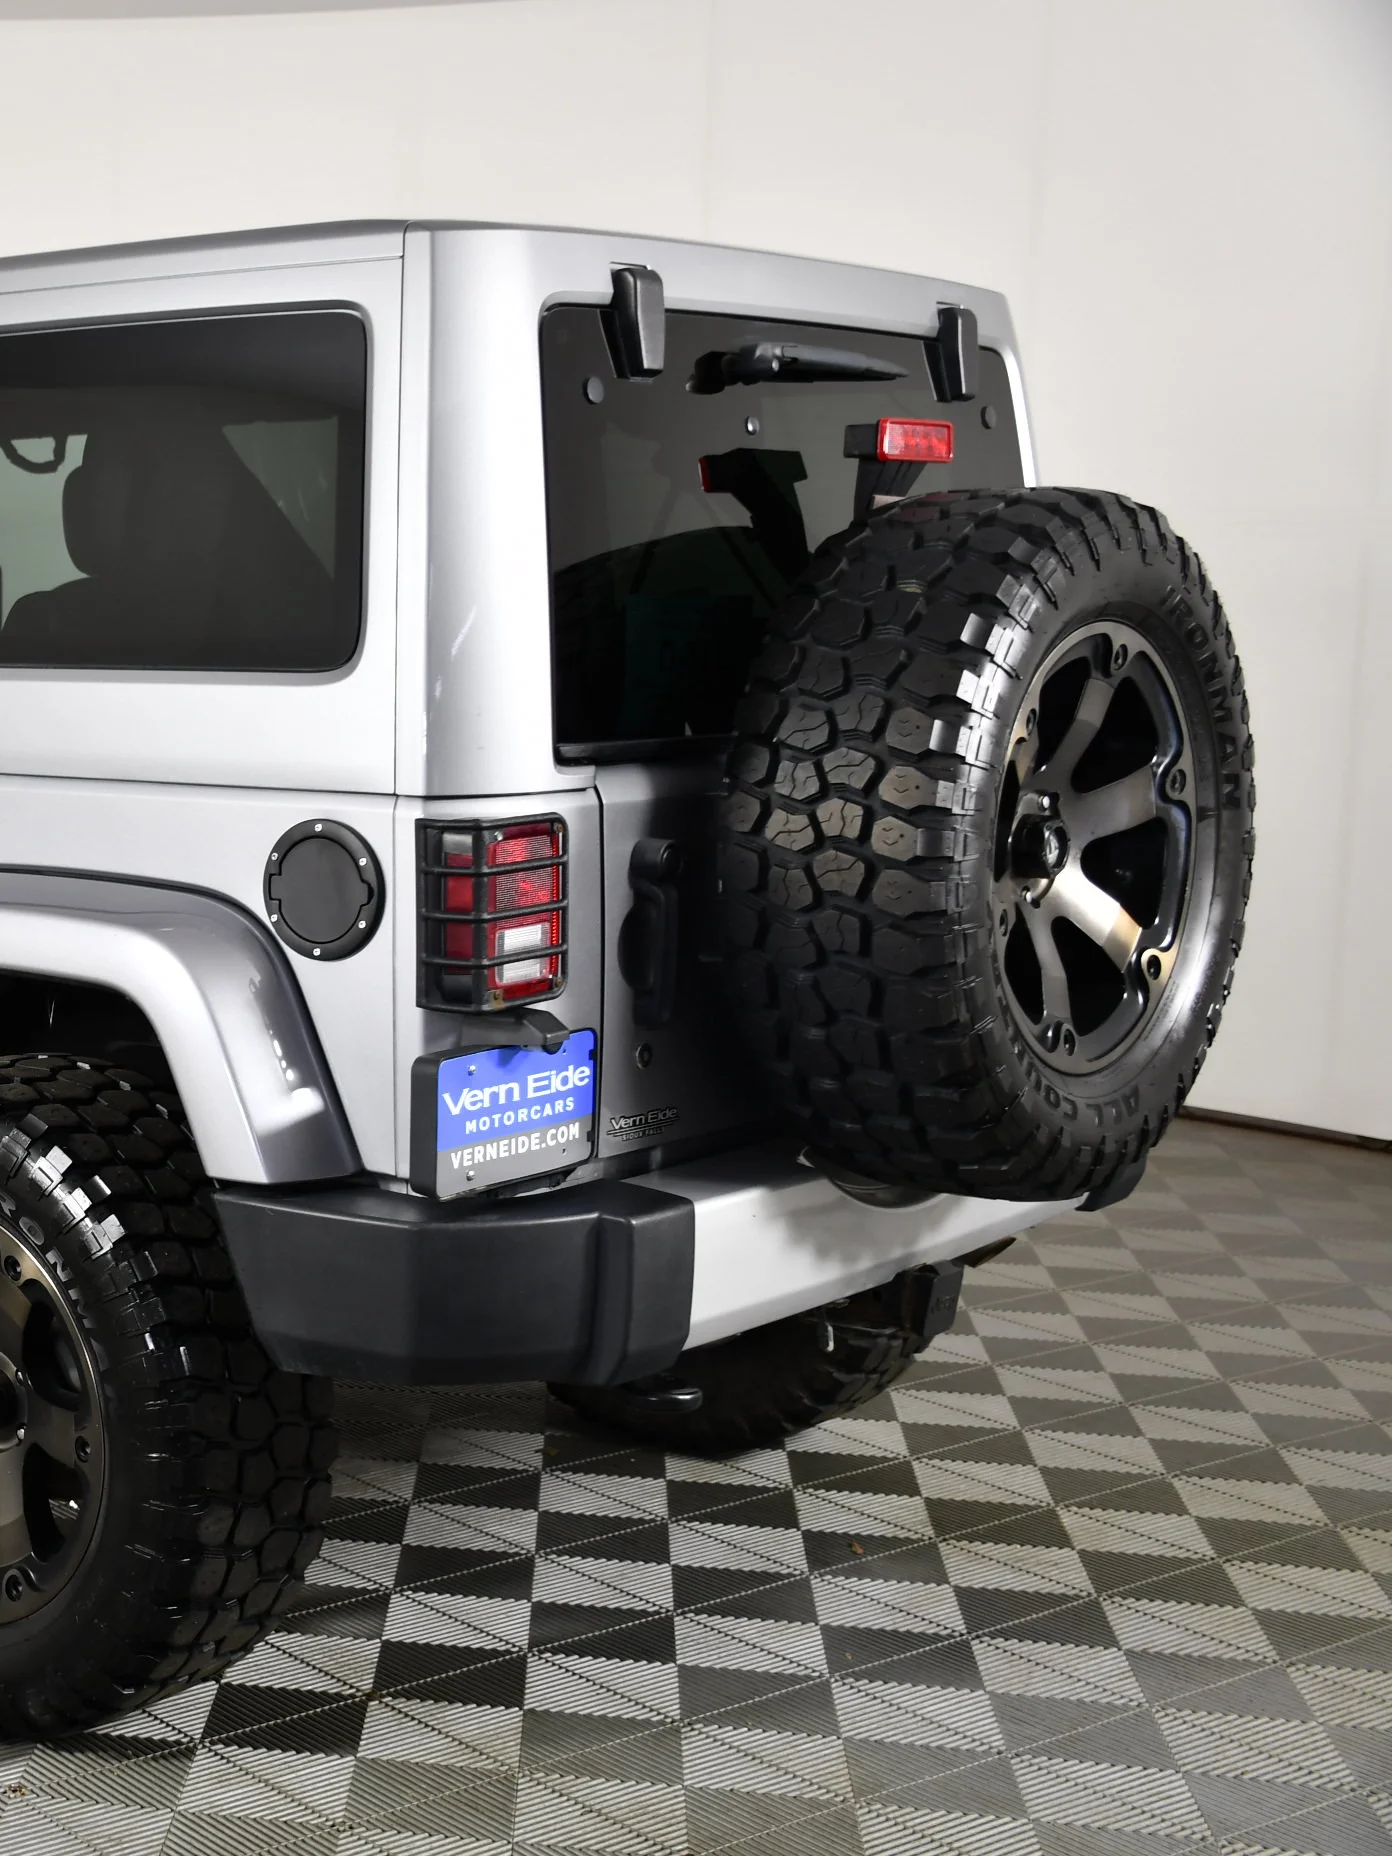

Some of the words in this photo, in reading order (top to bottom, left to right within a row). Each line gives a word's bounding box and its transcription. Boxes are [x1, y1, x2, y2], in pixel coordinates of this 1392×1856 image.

[1160, 584, 1241, 808] IRONMAN
[442, 1080, 520, 1116] Vern
[527, 1065, 591, 1099] Eide
[465, 1096, 575, 1134] MOTORCARS
[610, 1115, 645, 1130] Vern
[648, 1107, 678, 1122] Eide
[450, 1121, 580, 1169] VERNEIDE.COM
